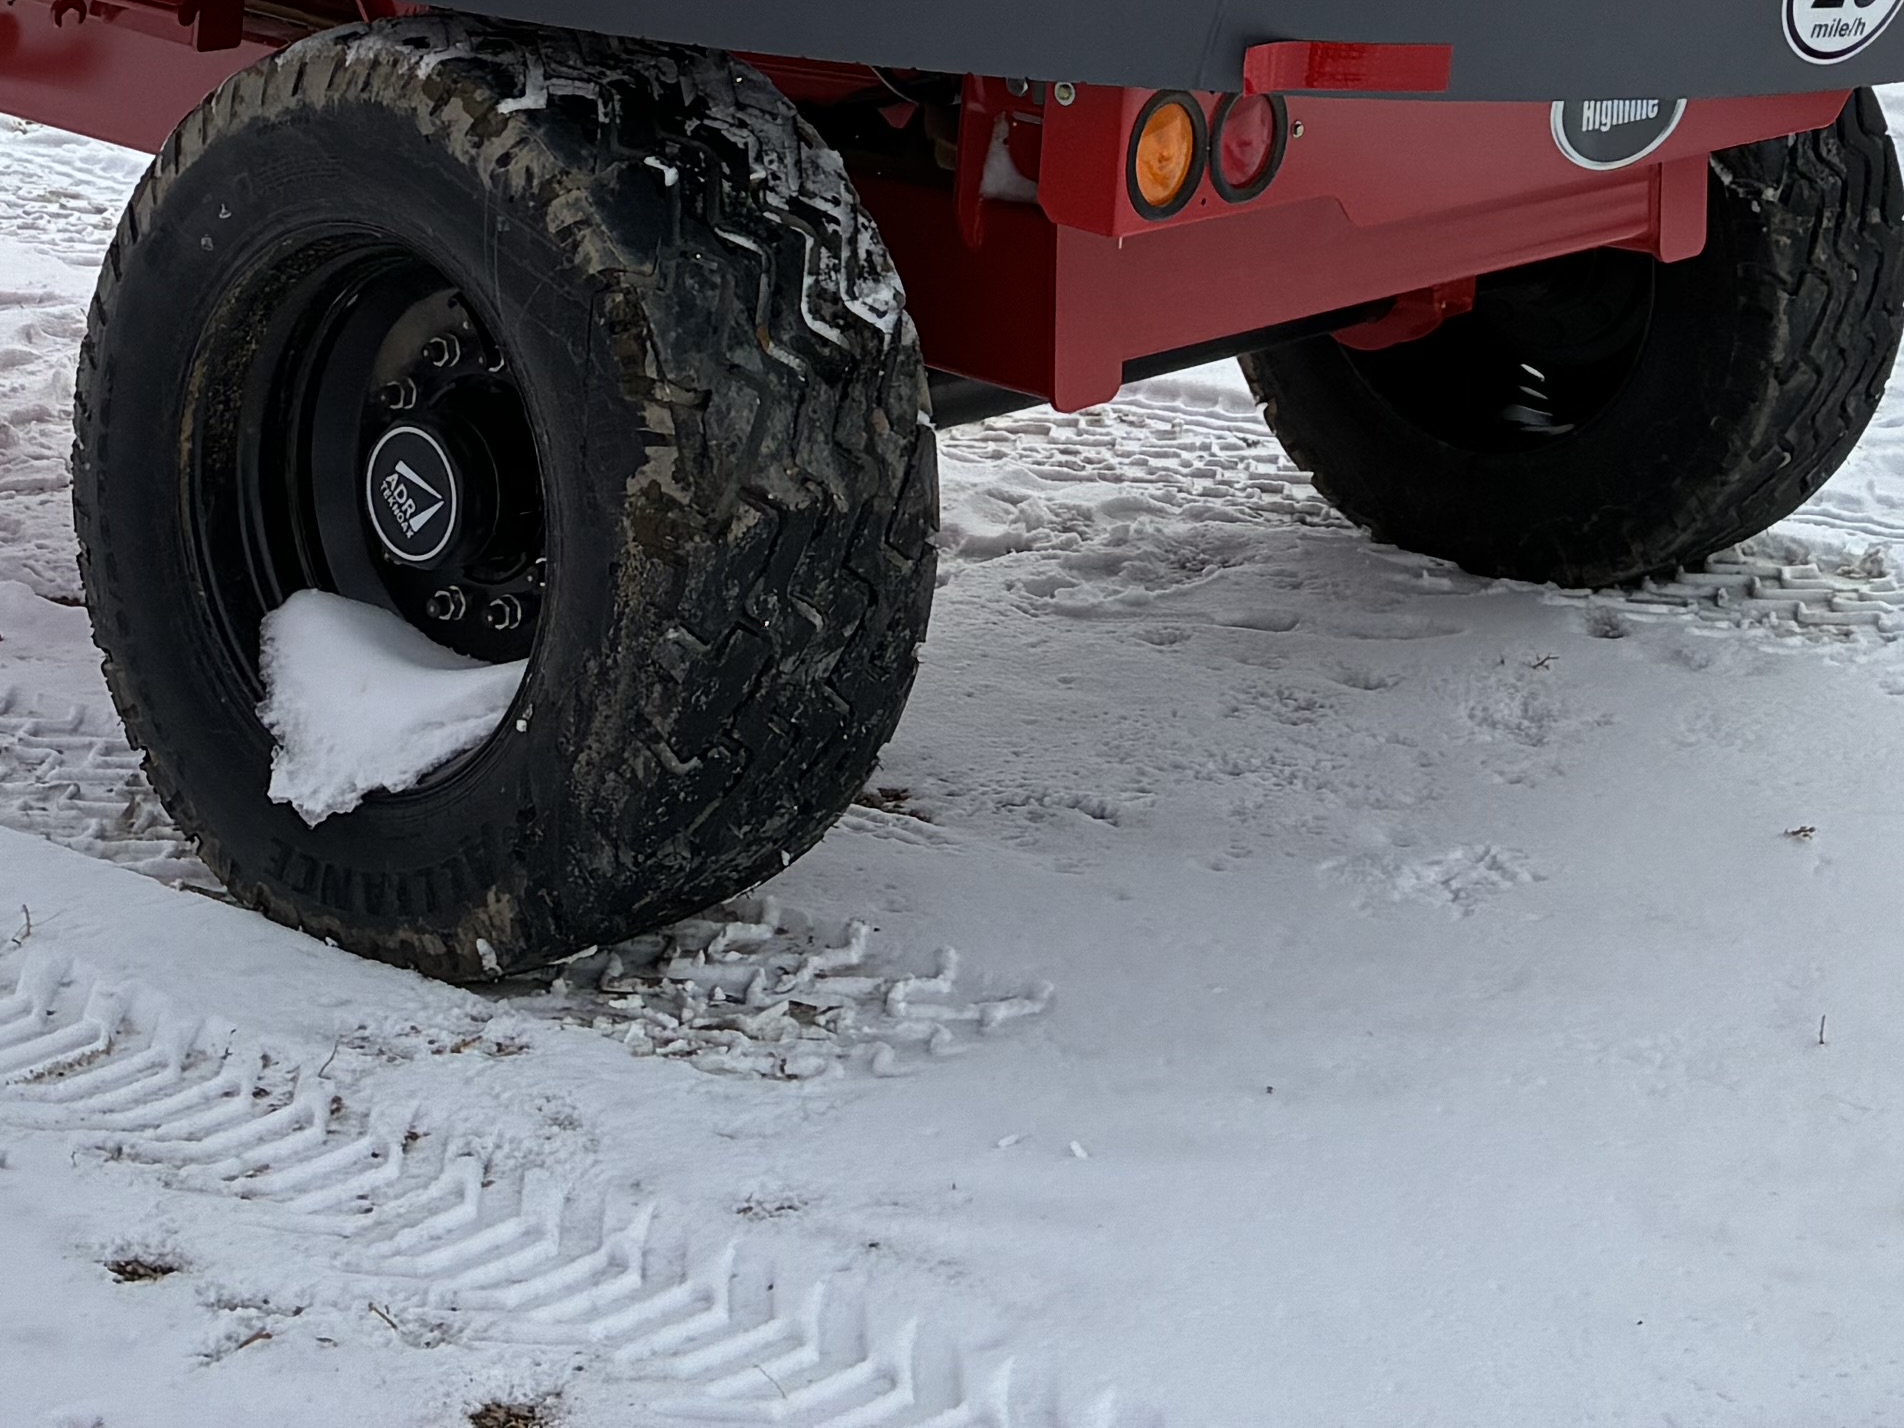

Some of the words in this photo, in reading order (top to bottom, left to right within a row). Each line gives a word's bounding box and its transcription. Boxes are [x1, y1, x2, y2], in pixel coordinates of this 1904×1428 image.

[1810, 17, 1867, 38] mile/h
[380, 480, 415, 539] TEKNOAX
[385, 473, 417, 519] ADR
